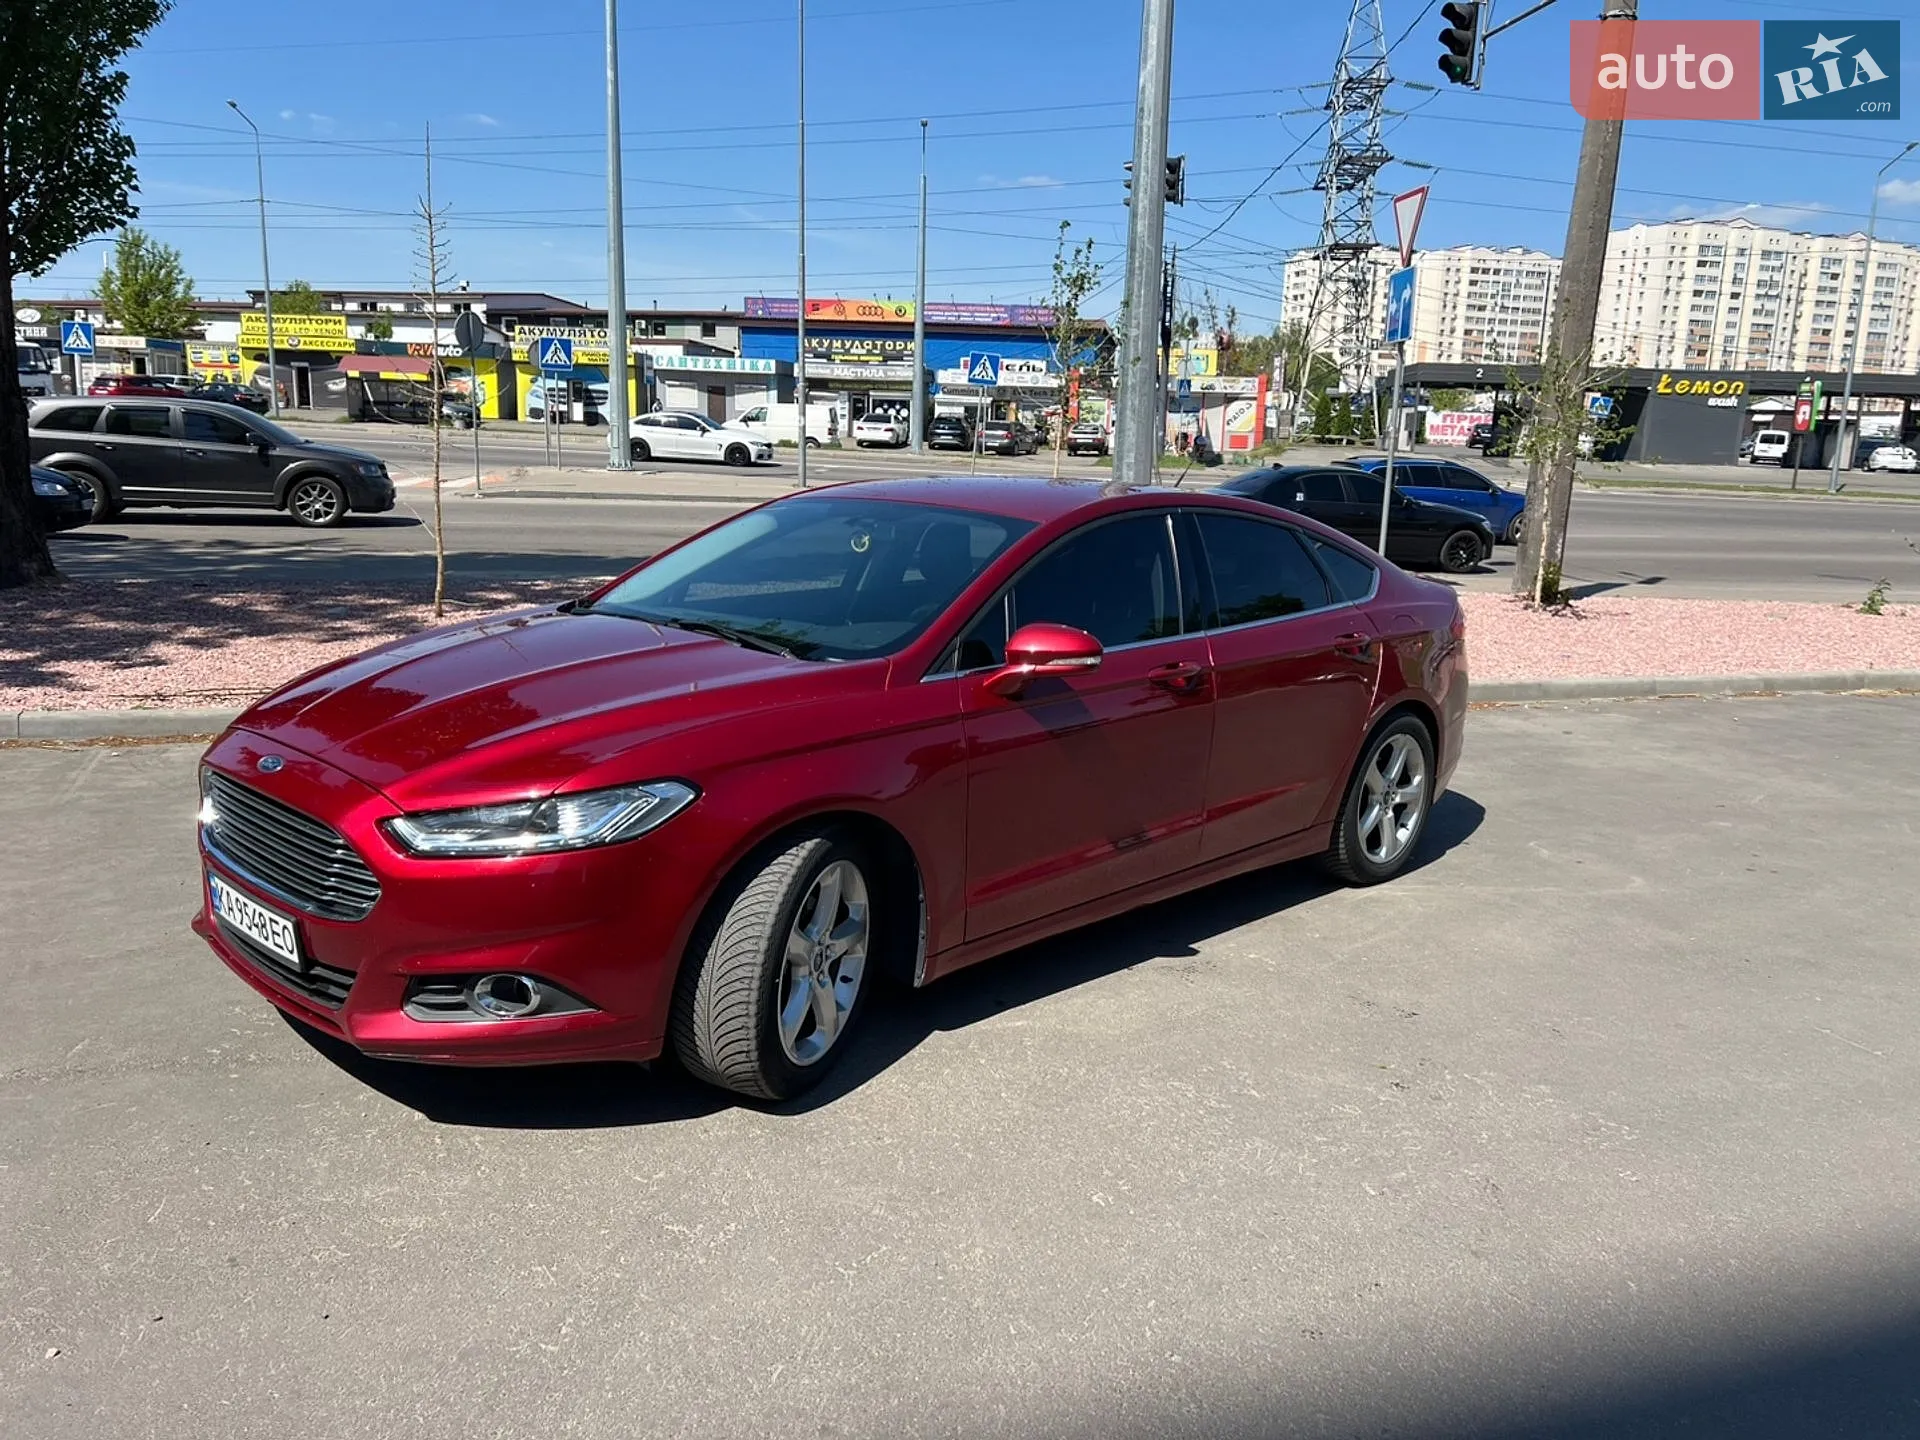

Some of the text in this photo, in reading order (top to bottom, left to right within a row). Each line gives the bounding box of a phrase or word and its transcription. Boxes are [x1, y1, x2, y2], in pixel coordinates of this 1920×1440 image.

[245, 326, 290, 334] АКУСИКА
[518, 326, 608, 339] АКУМУЛЯТО
[655, 354, 772, 371] САНТЕХНІКА
[833, 366, 885, 378] МАСТИЛА
[1475, 367, 1485, 379] 2
[1656, 373, 1745, 395] Lemon
